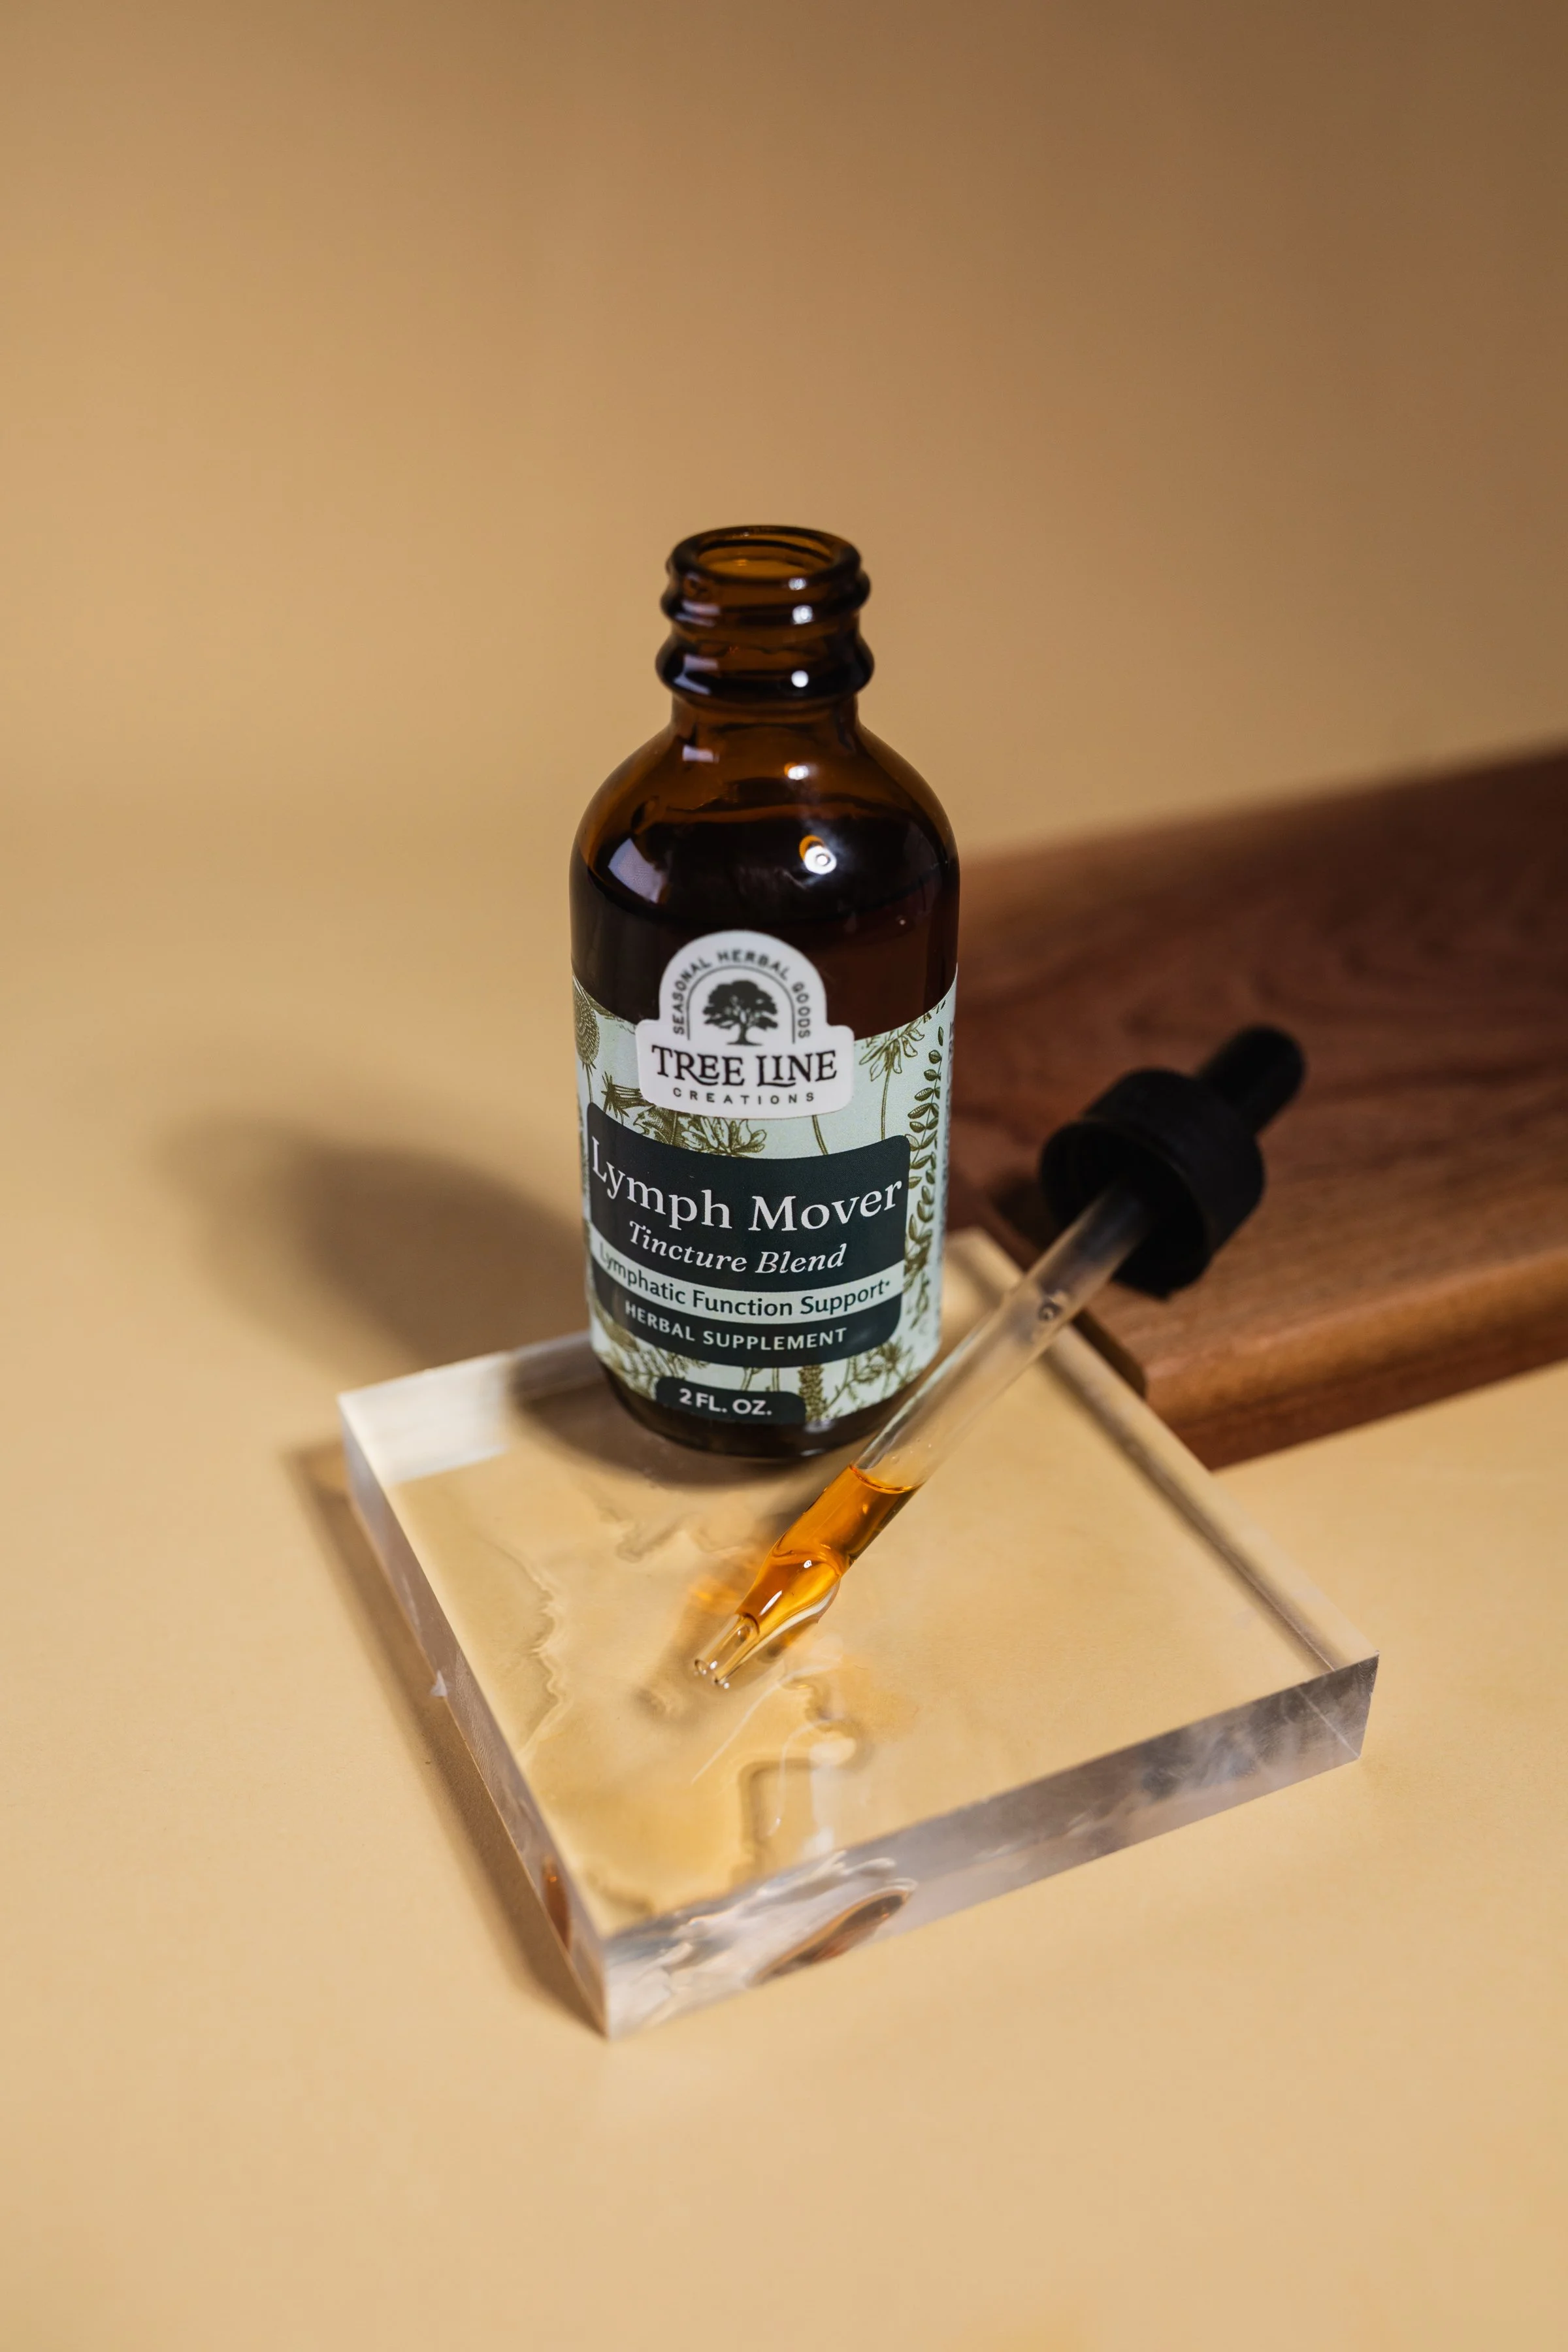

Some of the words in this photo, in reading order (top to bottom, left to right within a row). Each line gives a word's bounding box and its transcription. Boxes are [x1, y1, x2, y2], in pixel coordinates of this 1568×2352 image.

[672, 956, 712, 1036] SEASONAL
[717, 949, 790, 981] HERBAL
[791, 981, 811, 1039] GOODS
[651, 1044, 745, 1086] TREE
[755, 1049, 838, 1087] LINE
[672, 1086, 815, 1105] CREATIONS
[591, 1135, 733, 1231] Lymph
[747, 1180, 903, 1232] Mover
[629, 1220, 748, 1273] Tincture
[754, 1243, 847, 1274] Blend
[599, 1242, 686, 1305] Lymphatic
[692, 1289, 792, 1316] Function
[624, 1300, 696, 1342] HERBAL
[702, 1327, 847, 1351] SUPPLEMENT
[679, 1388, 693, 1406] 2
[695, 1392, 728, 1413] FL.
[732, 1399, 772, 1416] OZ.
